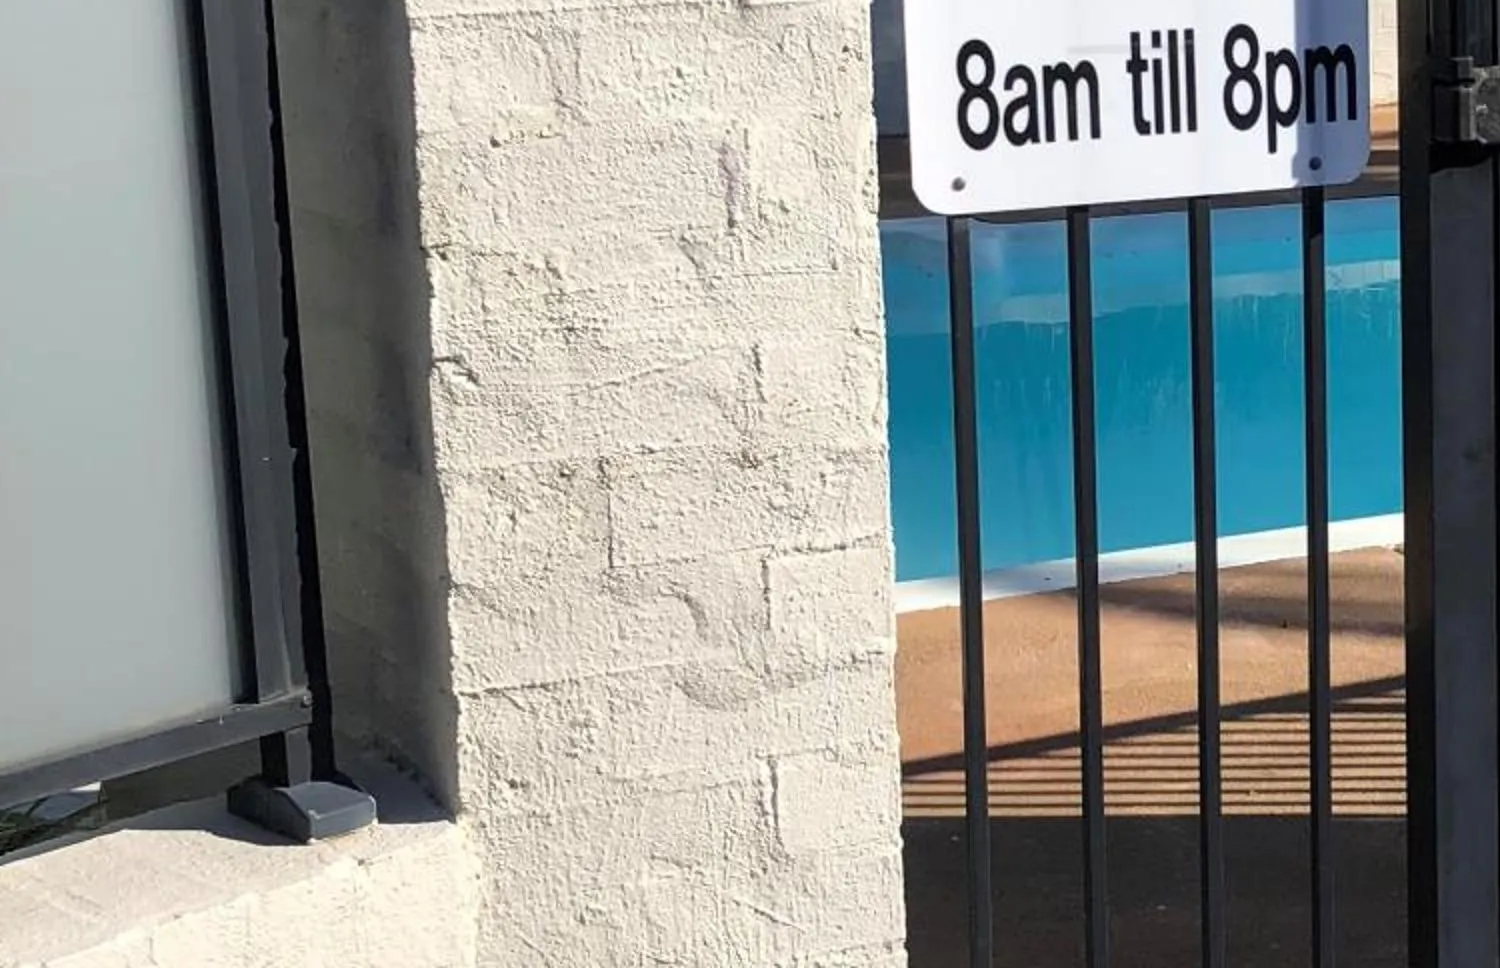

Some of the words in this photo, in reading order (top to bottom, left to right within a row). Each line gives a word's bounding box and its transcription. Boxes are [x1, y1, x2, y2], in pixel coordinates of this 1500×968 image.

[956, 39, 1102, 152] 8am
[1125, 23, 1199, 137] till
[1222, 23, 1359, 155] 8pm
